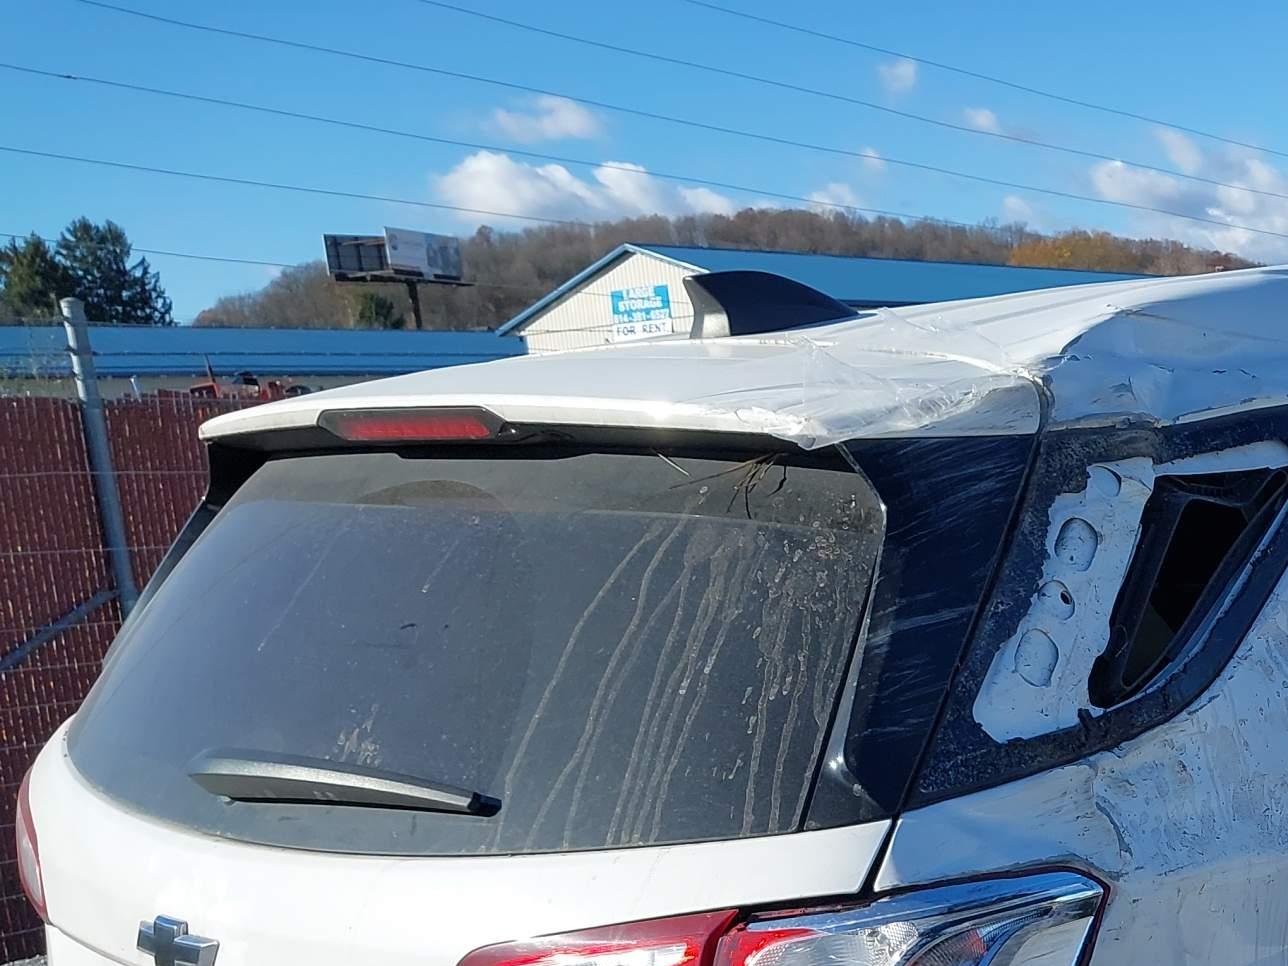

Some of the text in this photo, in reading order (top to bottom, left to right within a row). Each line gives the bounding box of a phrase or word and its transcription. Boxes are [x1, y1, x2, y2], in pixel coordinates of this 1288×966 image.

[618, 297, 664, 312] STORAGE
[616, 322, 667, 336] FOR RENT
